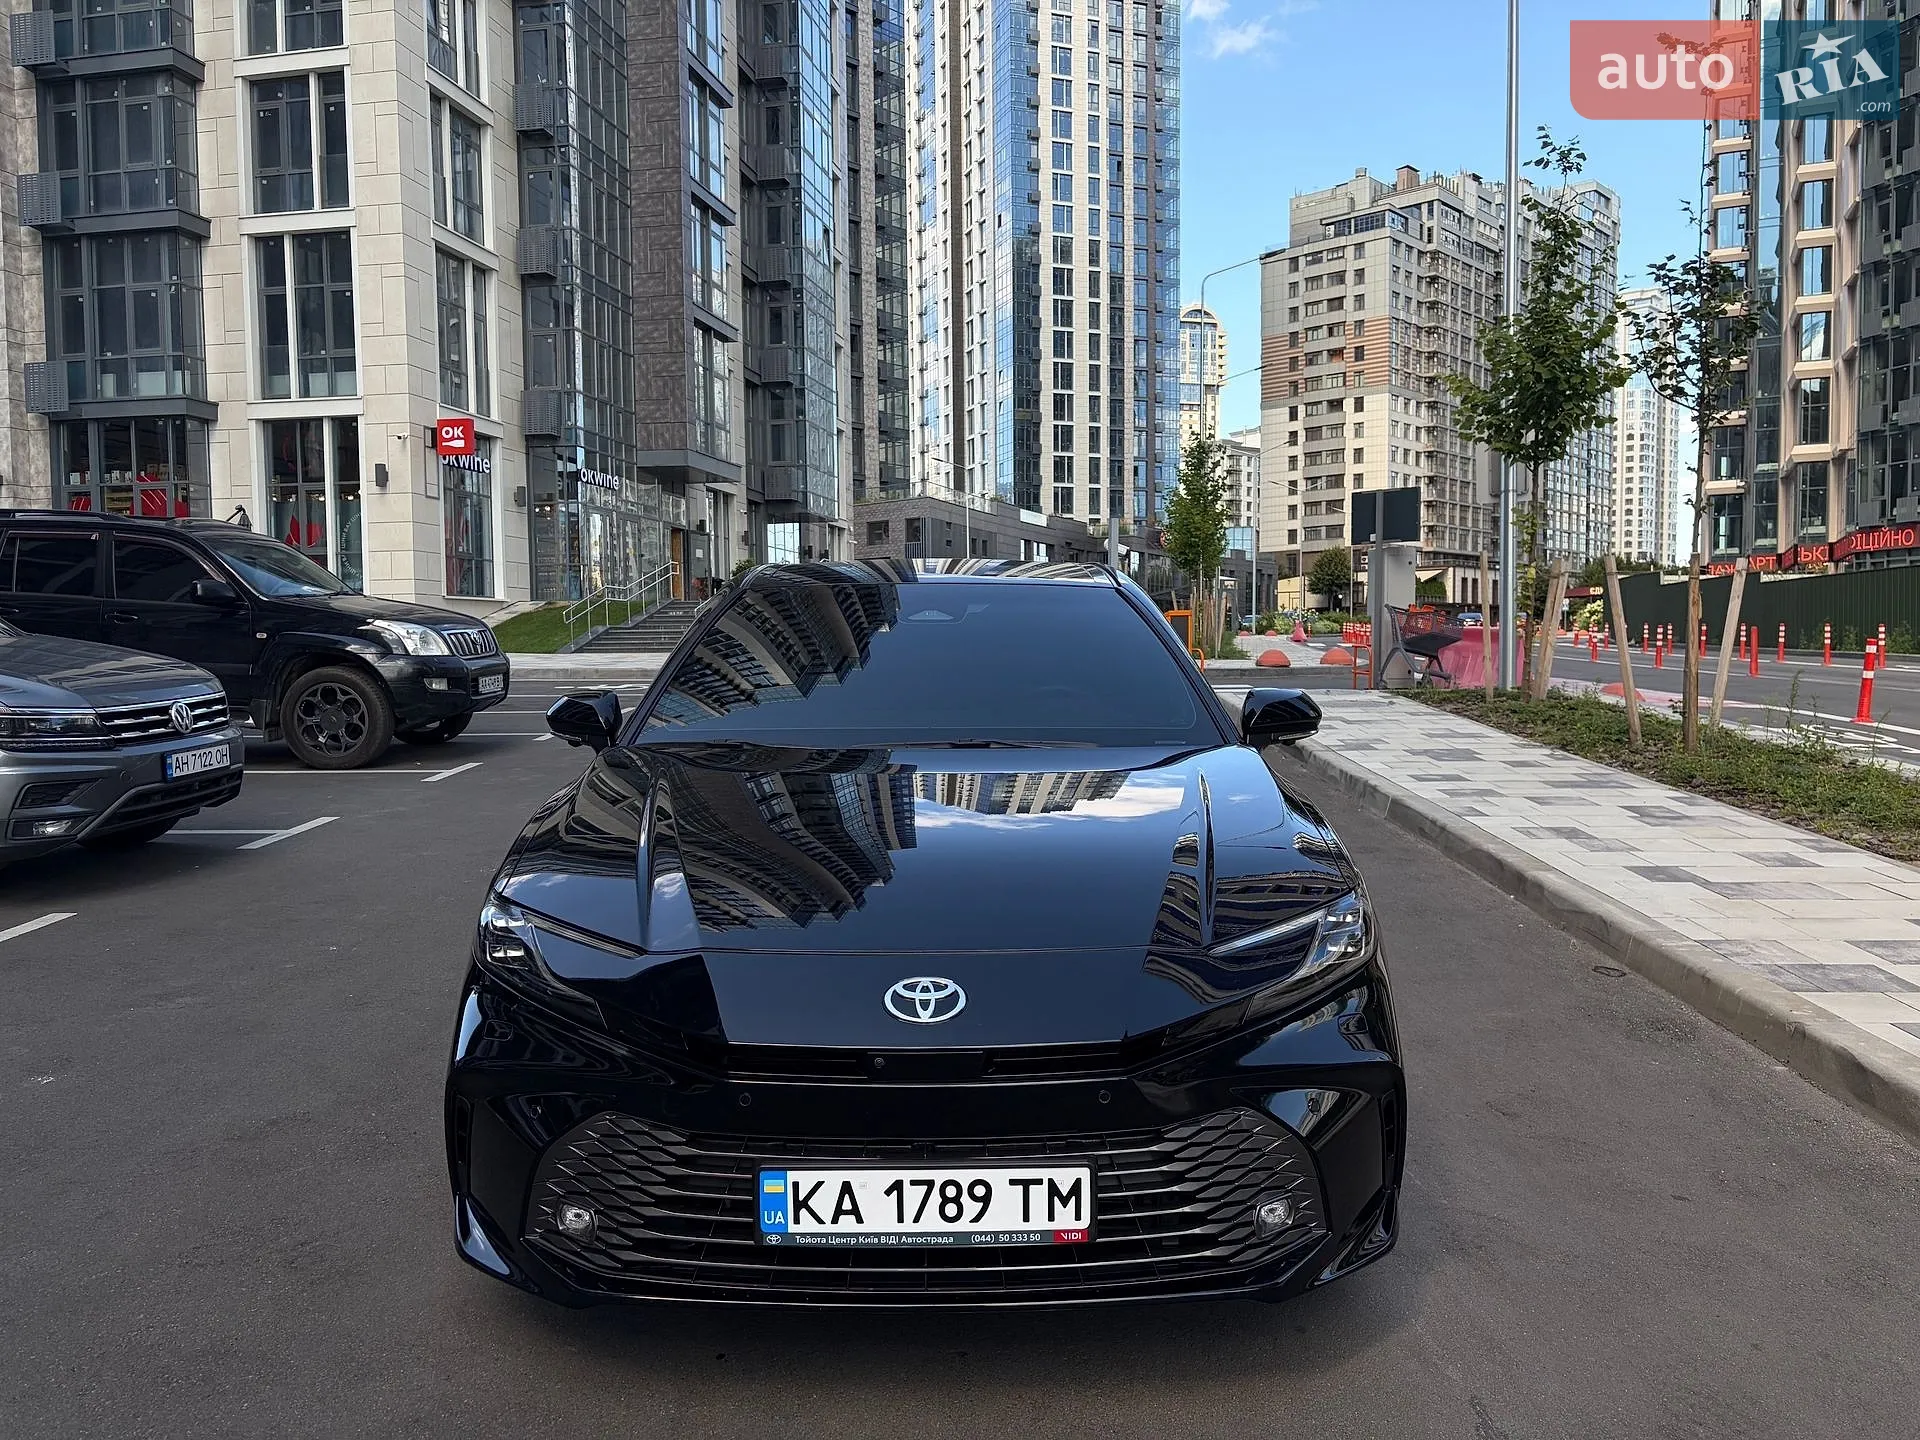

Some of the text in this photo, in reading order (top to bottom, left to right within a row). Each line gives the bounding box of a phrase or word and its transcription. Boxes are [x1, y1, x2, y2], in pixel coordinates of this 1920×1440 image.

[441, 426, 465, 439] OK
[174, 745, 230, 774] AH 7122 OH
[792, 1177, 1082, 1225] KA 1789 TM
[764, 1211, 785, 1224] UA
[795, 1232, 1041, 1245] Тойота Центр Київ ВІДІ Автострада (044) 50 333 50
